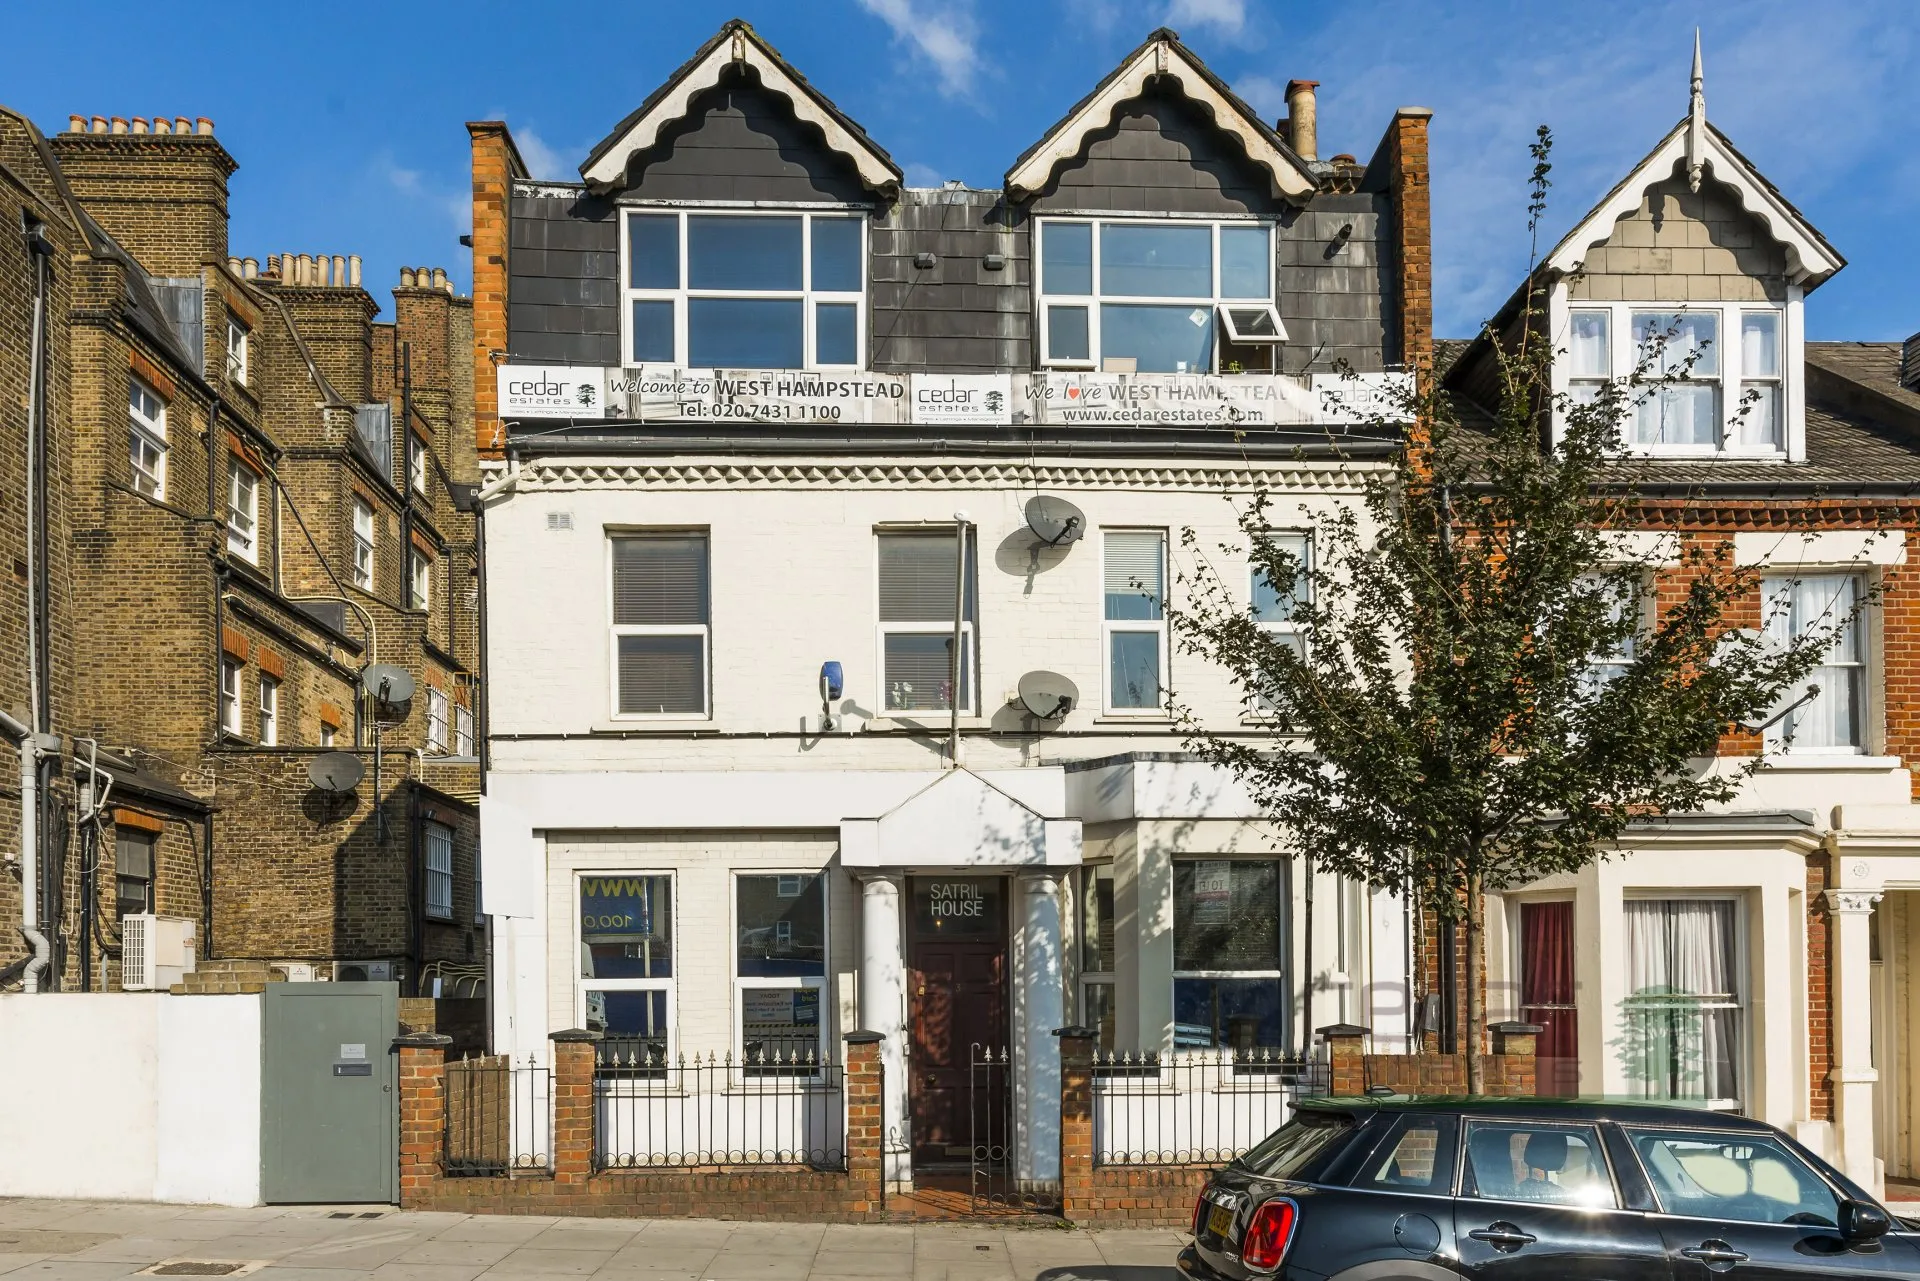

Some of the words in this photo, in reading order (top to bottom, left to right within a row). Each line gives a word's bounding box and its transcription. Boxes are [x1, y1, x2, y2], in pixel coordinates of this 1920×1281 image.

[509, 370, 571, 396] cedar
[610, 377, 686, 393] Welcome
[692, 380, 710, 394] to
[715, 380, 772, 396] WEST
[777, 381, 904, 399] HAMPSTEAD
[918, 378, 979, 403] cedar
[1025, 384, 1054, 400] We
[1108, 385, 1163, 400] WEST
[509, 397, 571, 405] estates
[918, 404, 979, 412] estates
[677, 403, 707, 417] Tel:
[799, 405, 842, 419] 1100
[930, 883, 983, 900] SATRIL
[931, 900, 983, 916] HOUSE
